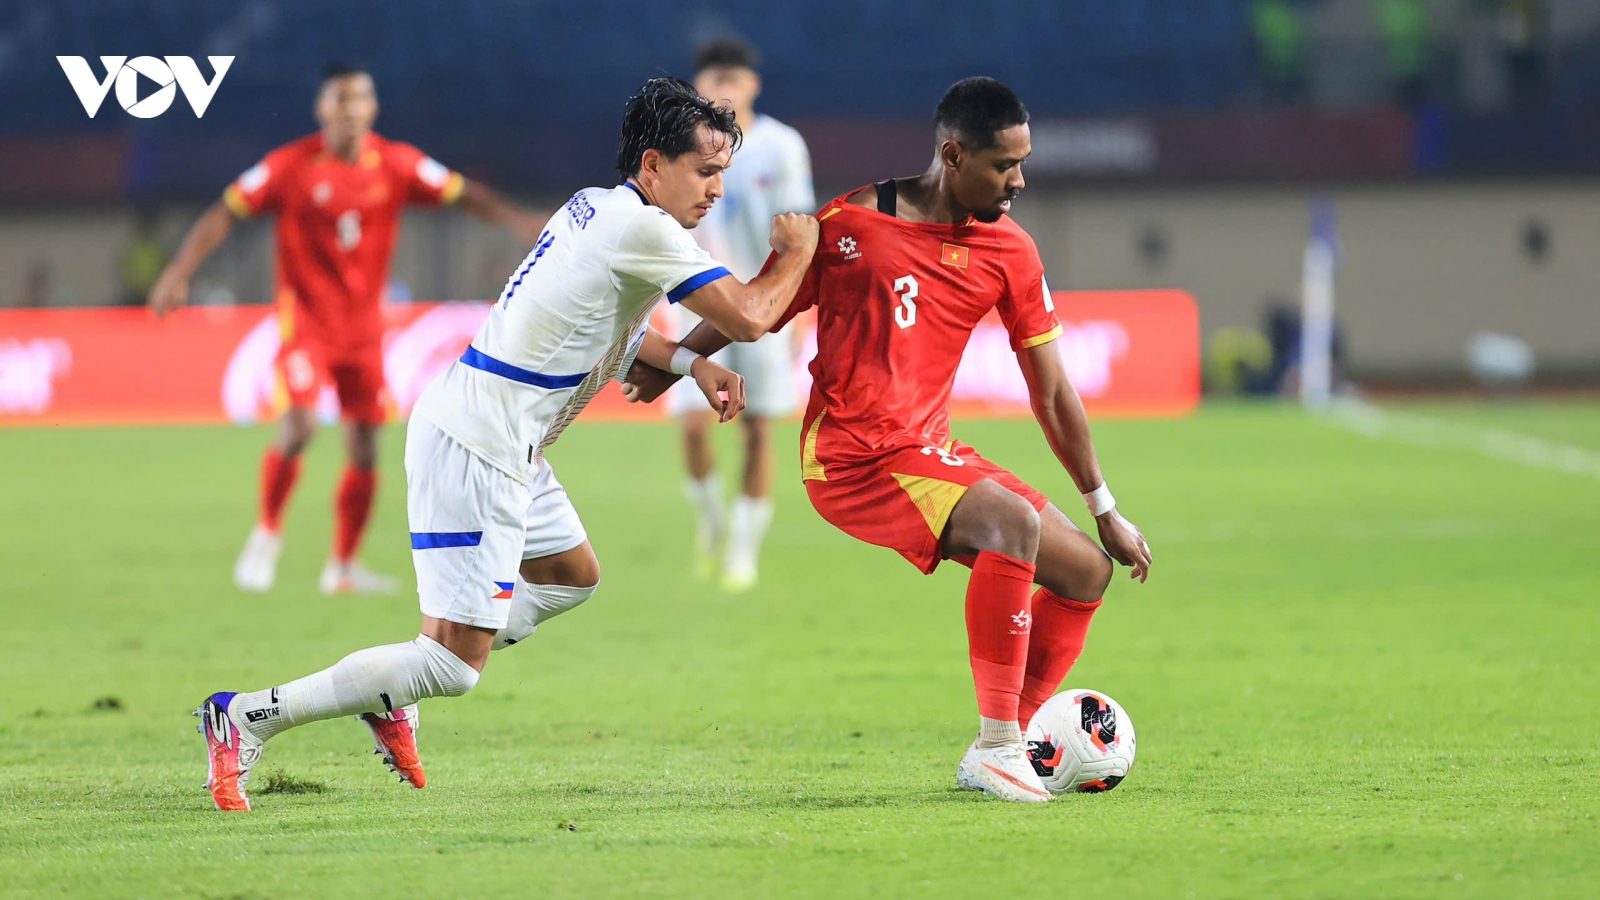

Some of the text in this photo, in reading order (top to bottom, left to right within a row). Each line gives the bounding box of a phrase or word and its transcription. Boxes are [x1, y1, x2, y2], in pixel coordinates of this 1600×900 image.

[503, 230, 555, 310] 1
[894, 274, 919, 330] 3
[920, 446, 965, 466] 3
